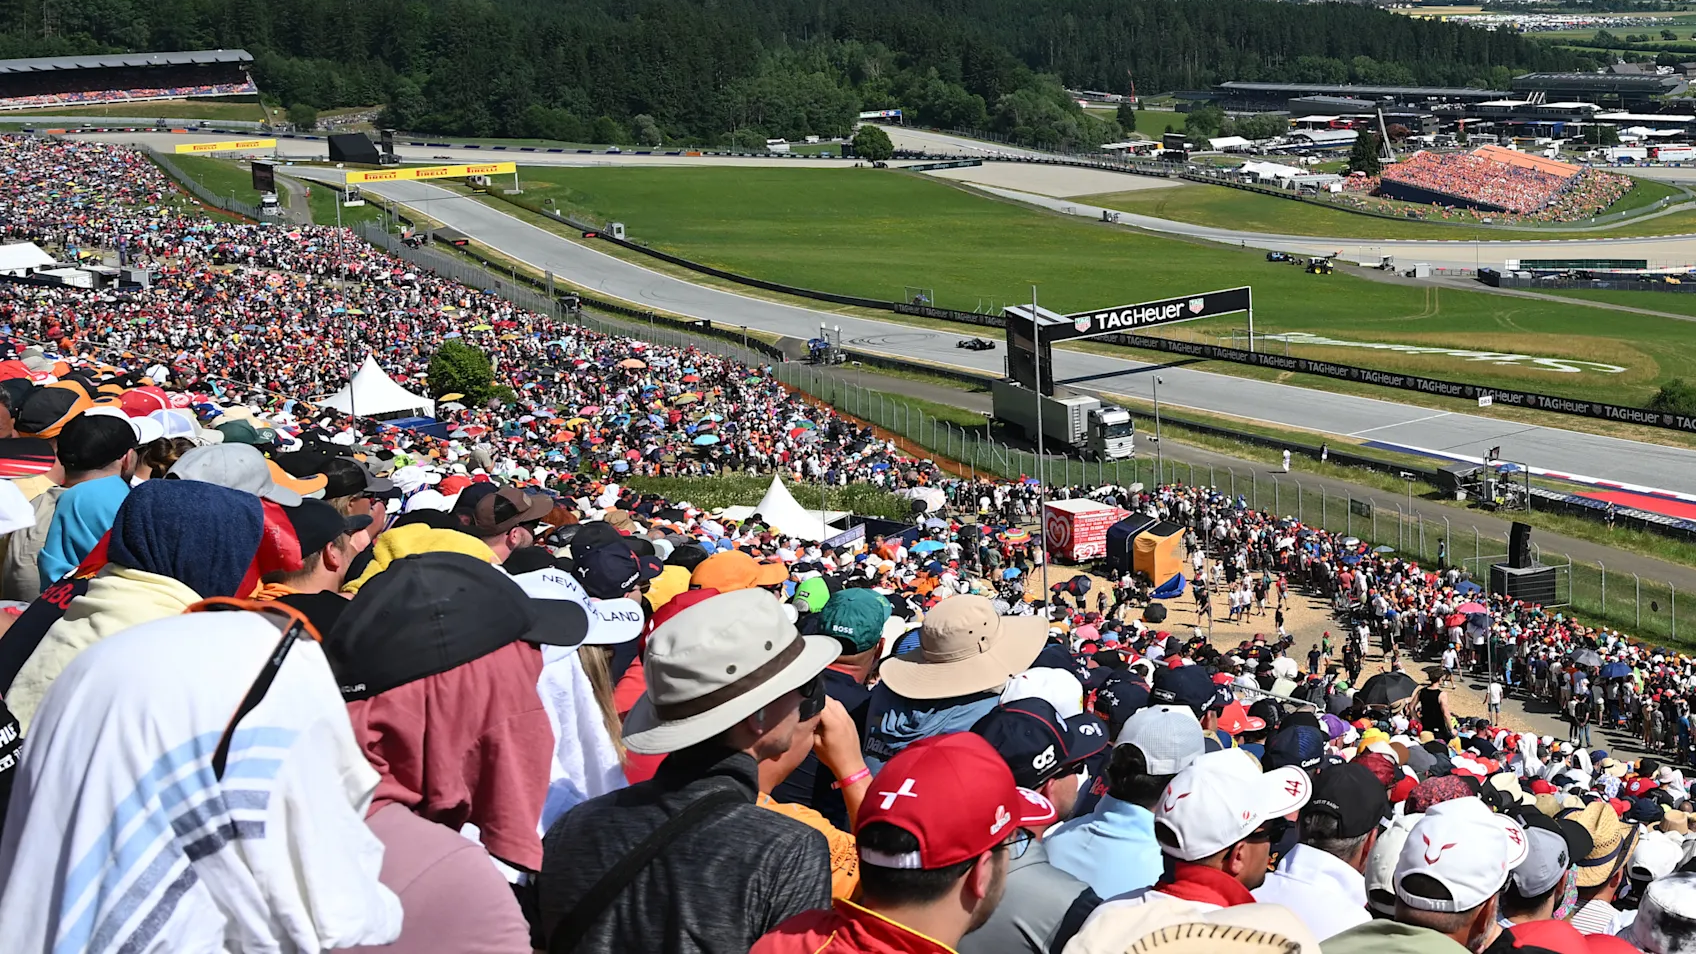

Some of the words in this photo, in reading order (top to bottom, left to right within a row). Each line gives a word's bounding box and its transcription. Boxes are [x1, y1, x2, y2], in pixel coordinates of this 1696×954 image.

[1095, 301, 1185, 330] TAGHeuer
[1480, 398, 1491, 406] DRS
[542, 574, 577, 592] NEW
[832, 624, 854, 635] BOSS
[1284, 780, 1303, 797] 44
[1505, 826, 1522, 846] 44
